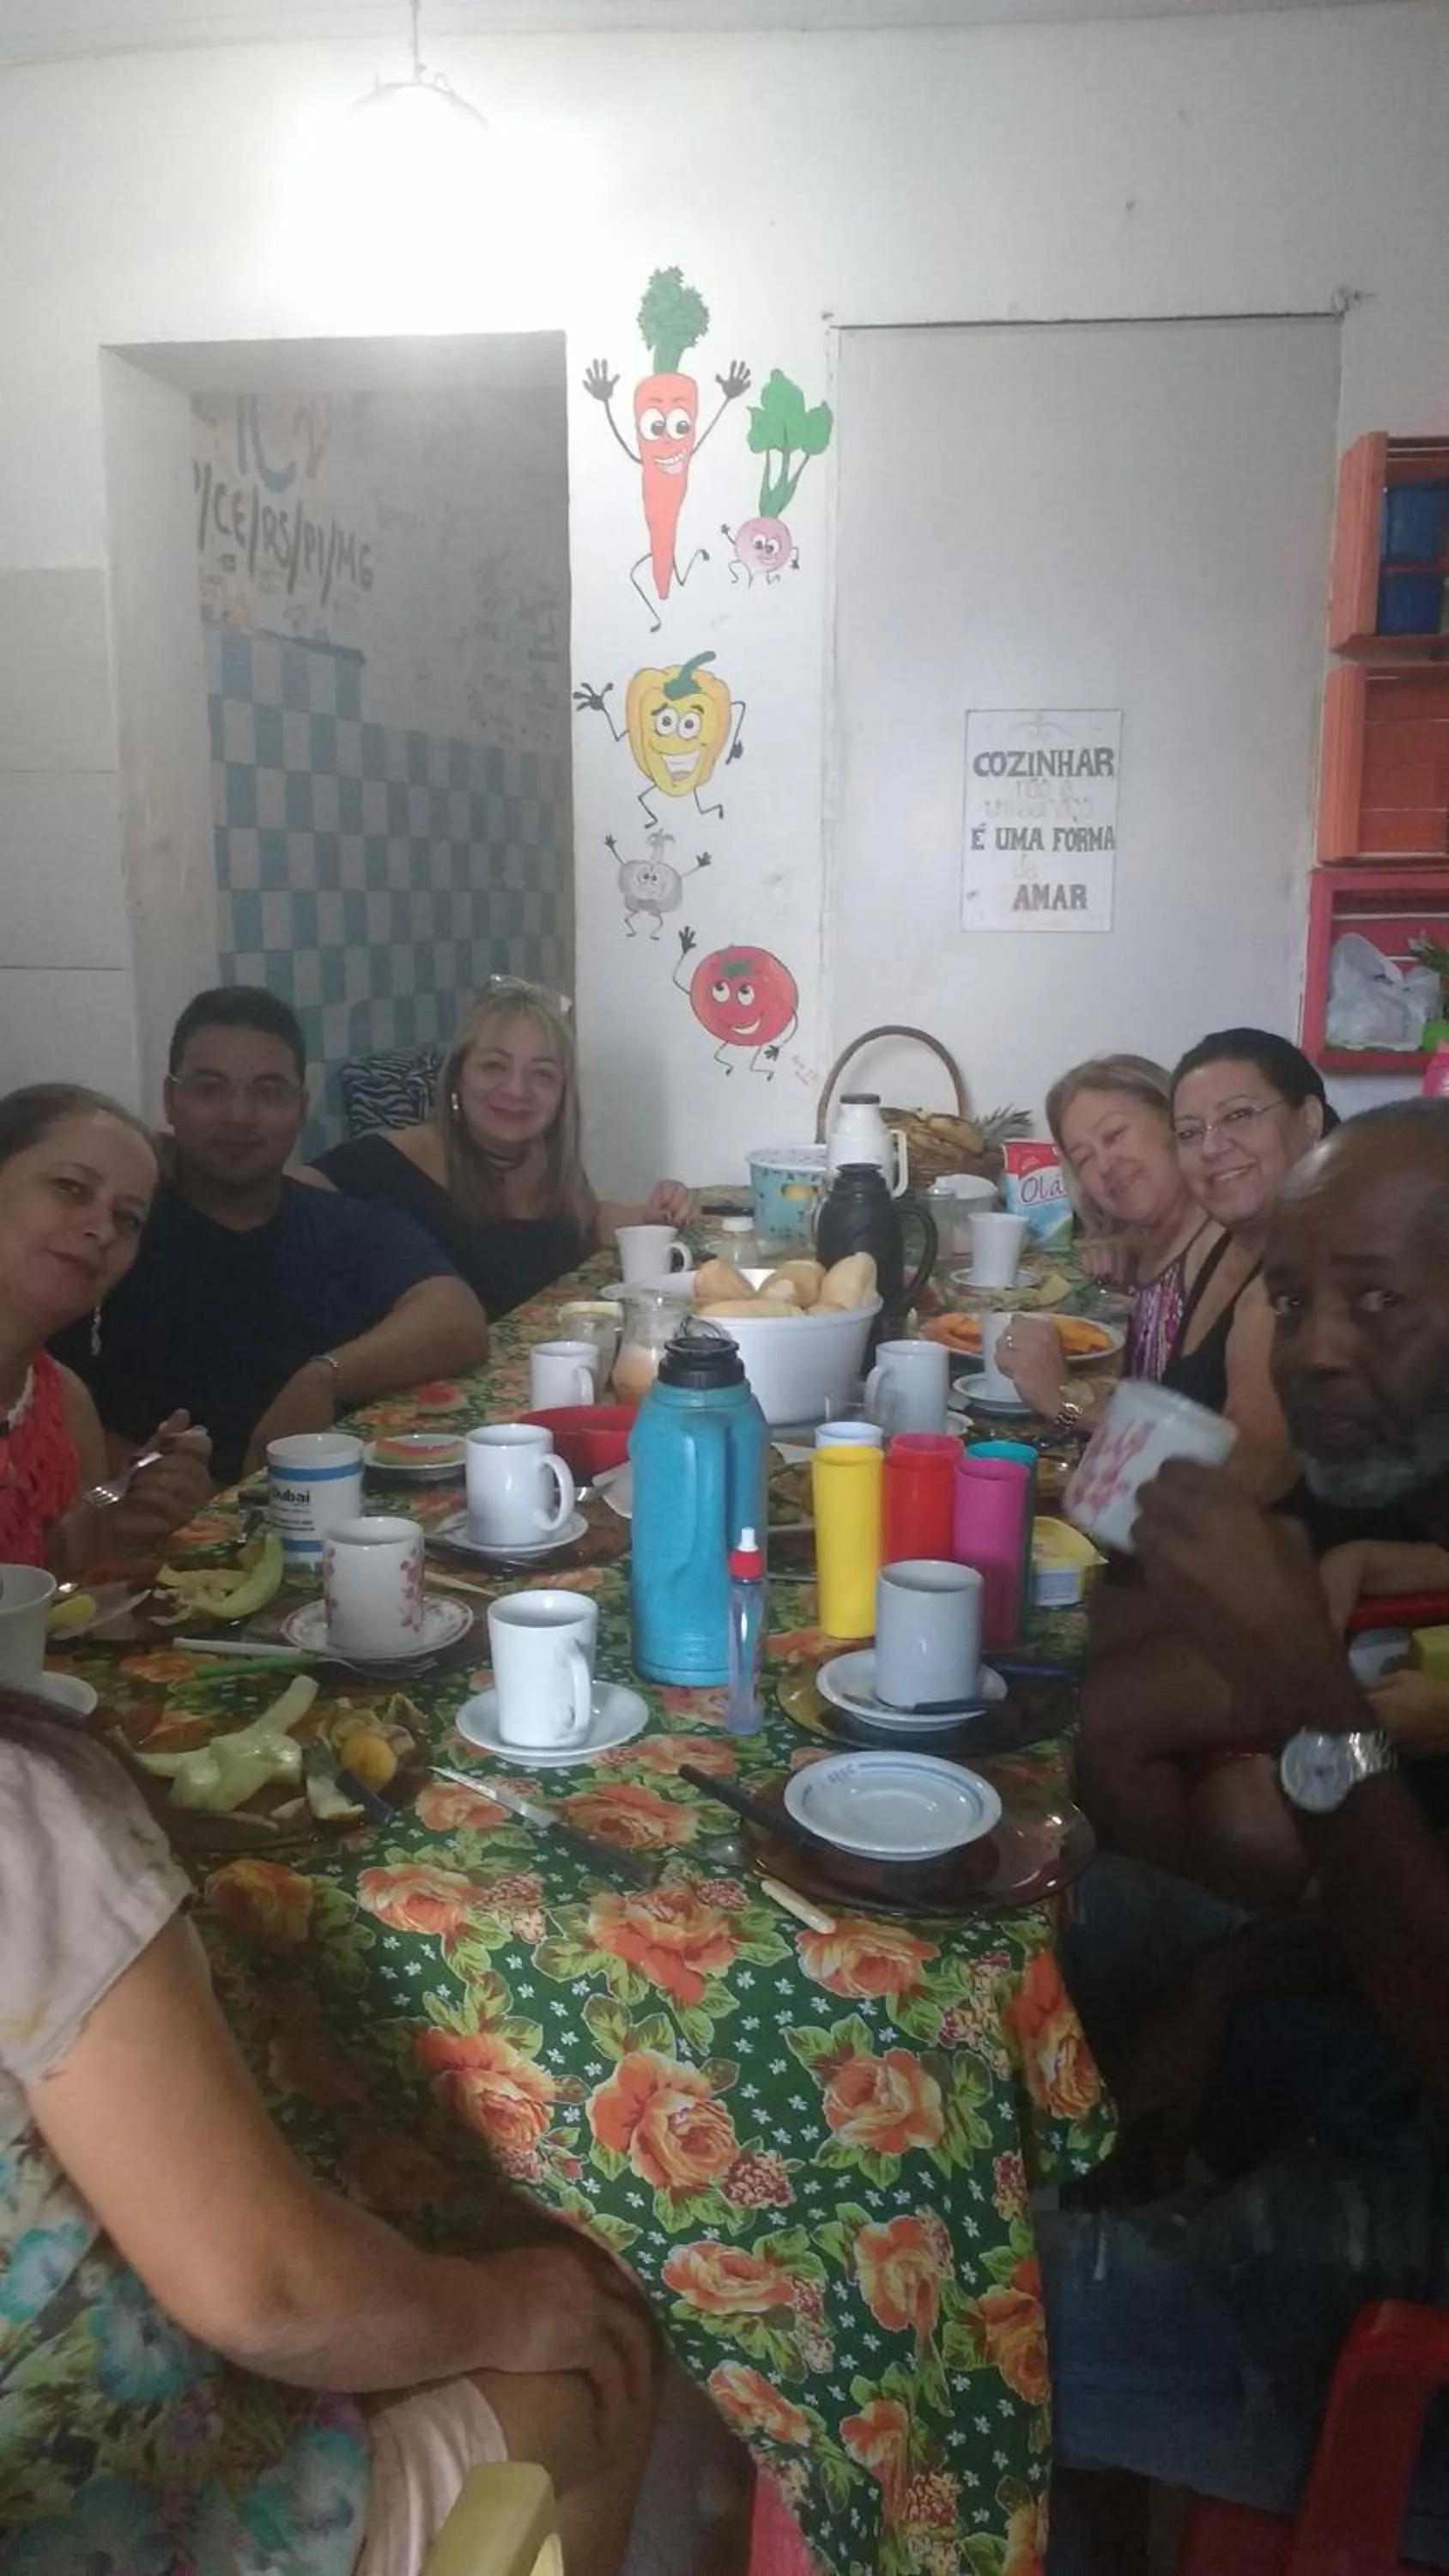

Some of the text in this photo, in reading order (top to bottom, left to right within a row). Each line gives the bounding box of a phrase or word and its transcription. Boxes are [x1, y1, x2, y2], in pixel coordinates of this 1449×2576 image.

[973, 747, 1115, 778] COZINHAR
[971, 822, 1116, 852] É UMA FORMA
[1012, 884, 1088, 910] AMAR
